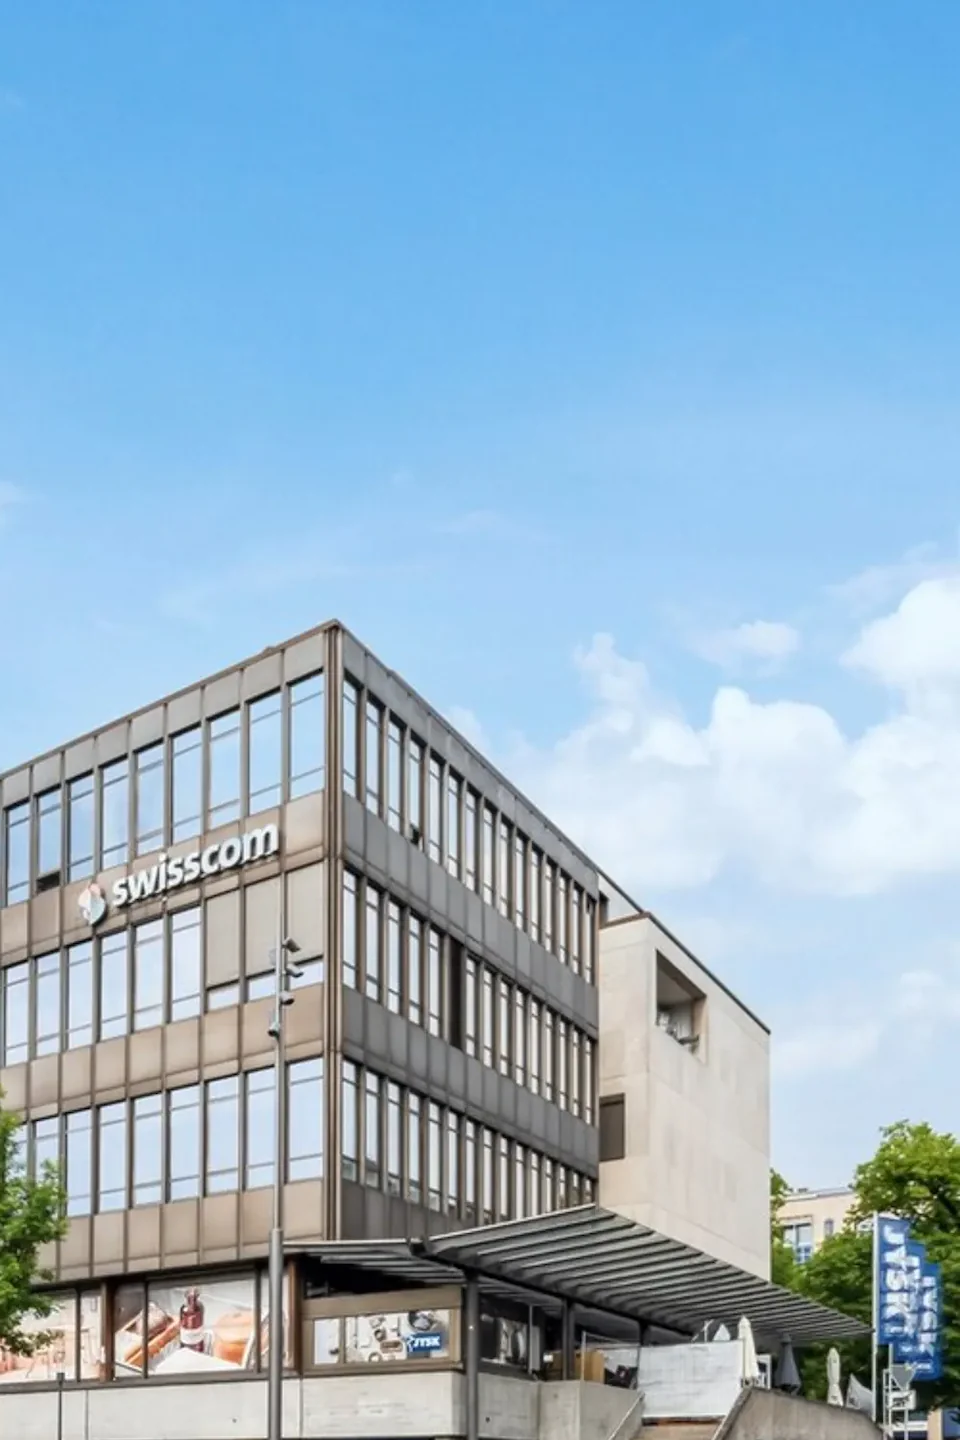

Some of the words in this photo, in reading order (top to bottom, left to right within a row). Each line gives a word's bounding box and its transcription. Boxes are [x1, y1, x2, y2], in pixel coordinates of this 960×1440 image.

[112, 823, 279, 906] swisscom
[883, 1224, 909, 1319] JYSK
[414, 1335, 440, 1347] JYSK
